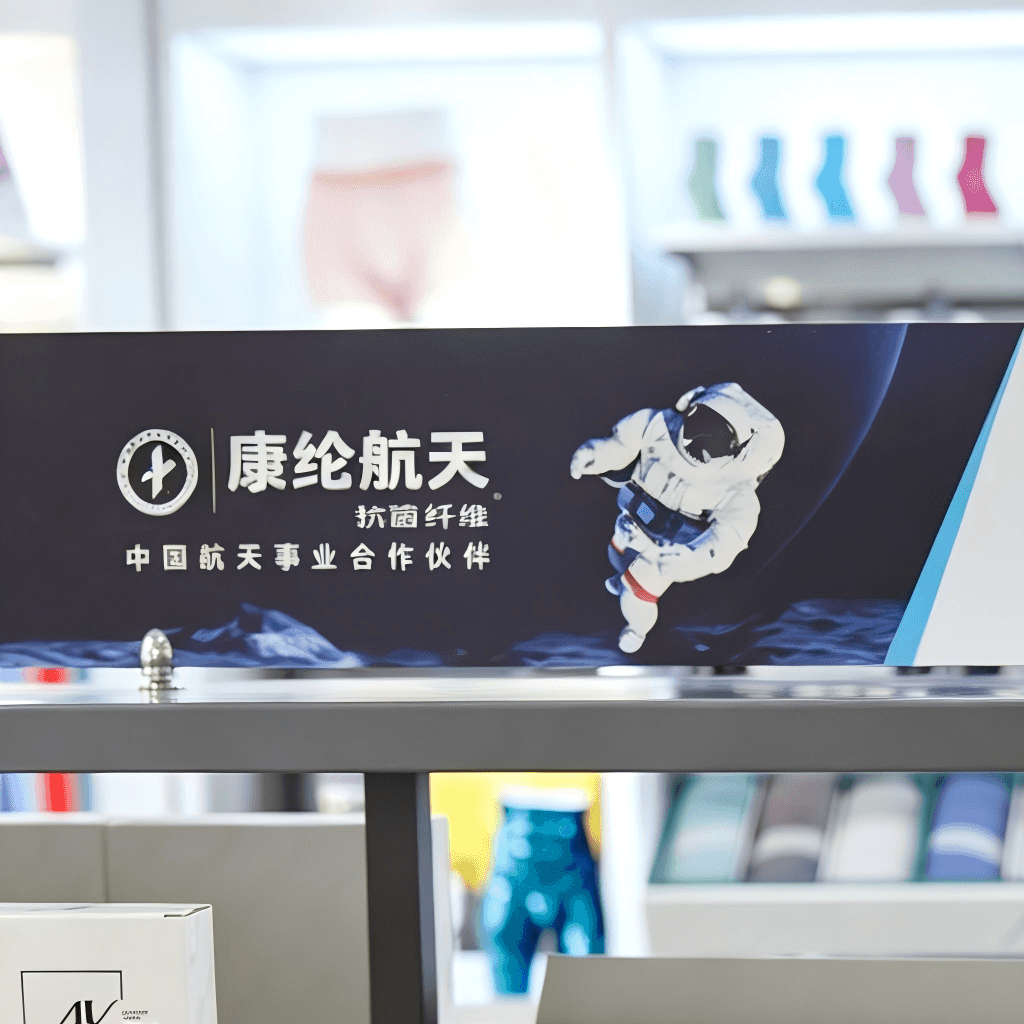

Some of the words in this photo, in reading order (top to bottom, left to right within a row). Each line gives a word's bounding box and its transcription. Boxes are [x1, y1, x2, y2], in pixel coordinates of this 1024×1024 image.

[227, 429, 490, 494] 康纶航天
[125, 540, 492, 573] 中国航天事业合作伙伴
